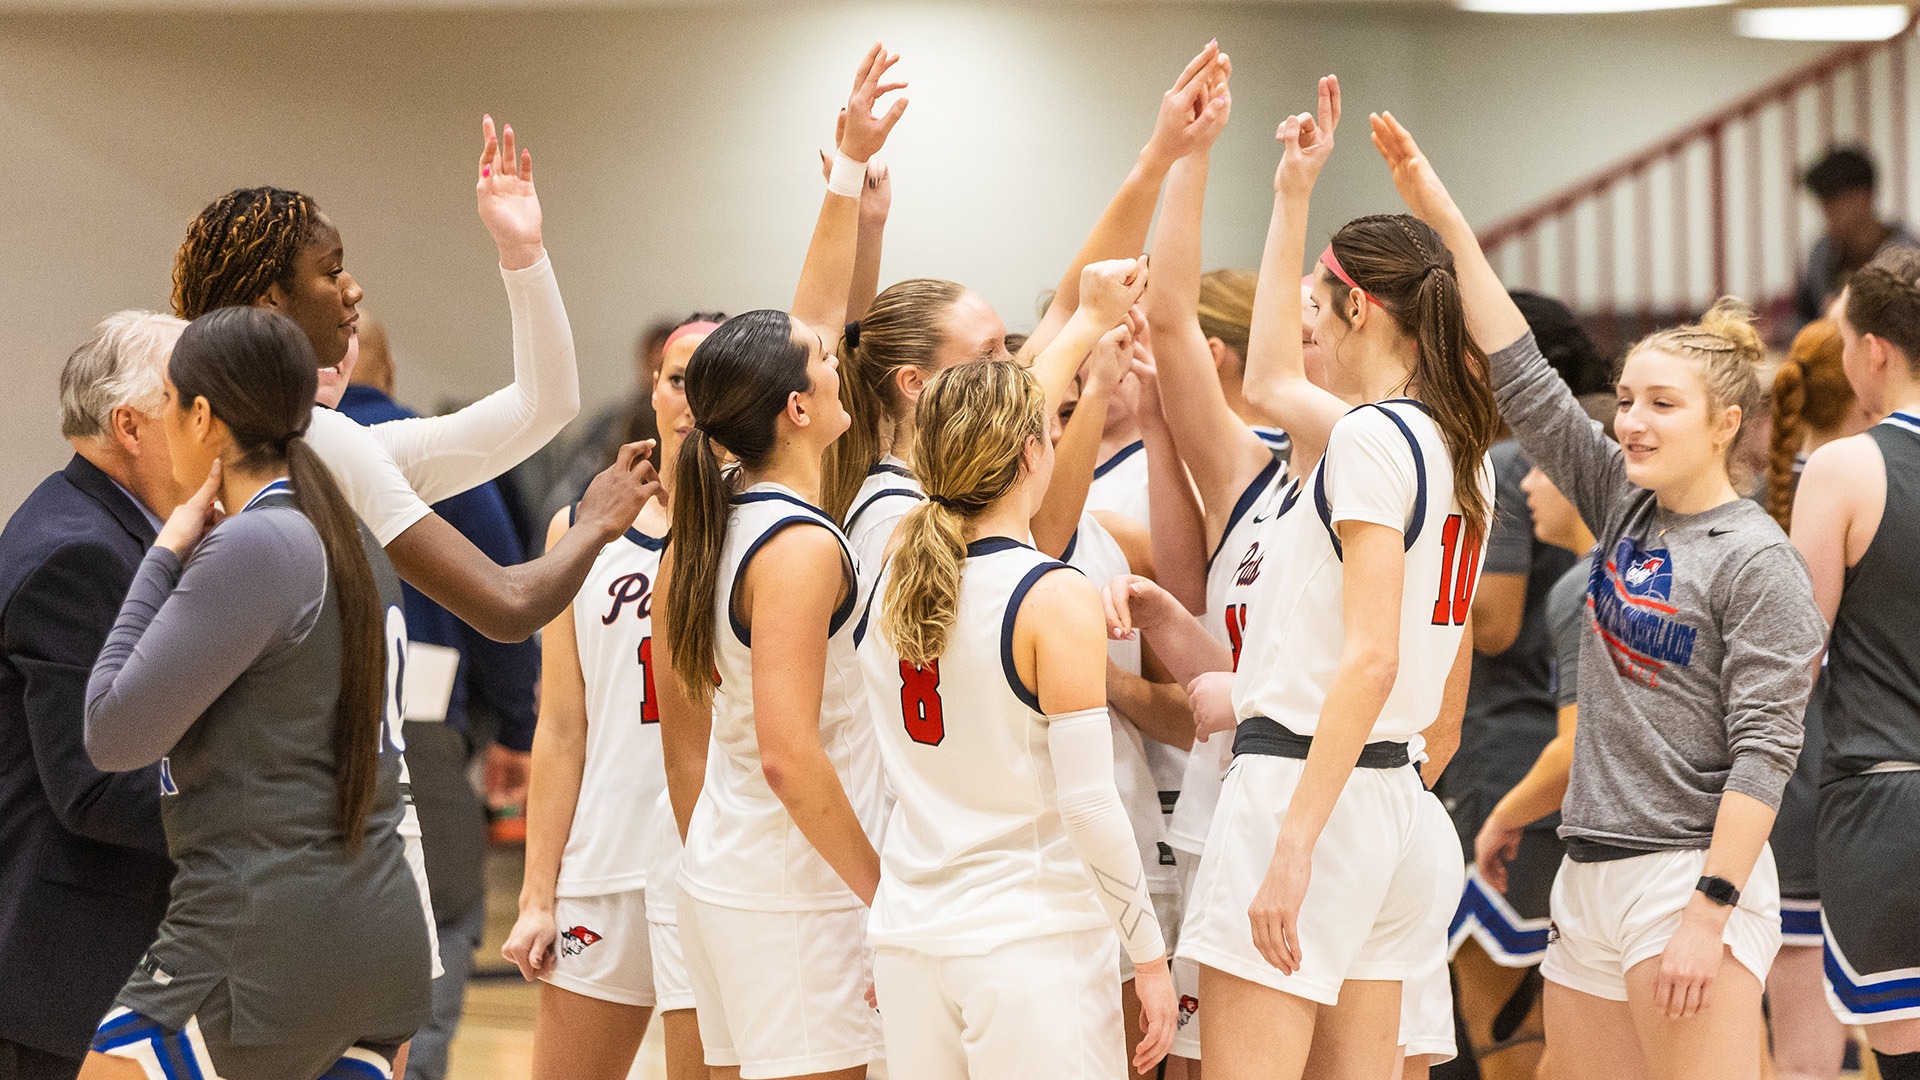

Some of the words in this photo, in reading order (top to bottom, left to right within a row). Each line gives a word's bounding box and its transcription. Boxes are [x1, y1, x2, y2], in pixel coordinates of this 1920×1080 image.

[601, 572, 652, 626] Pa
[1431, 513, 1482, 626] 10
[898, 657, 945, 746] 8
